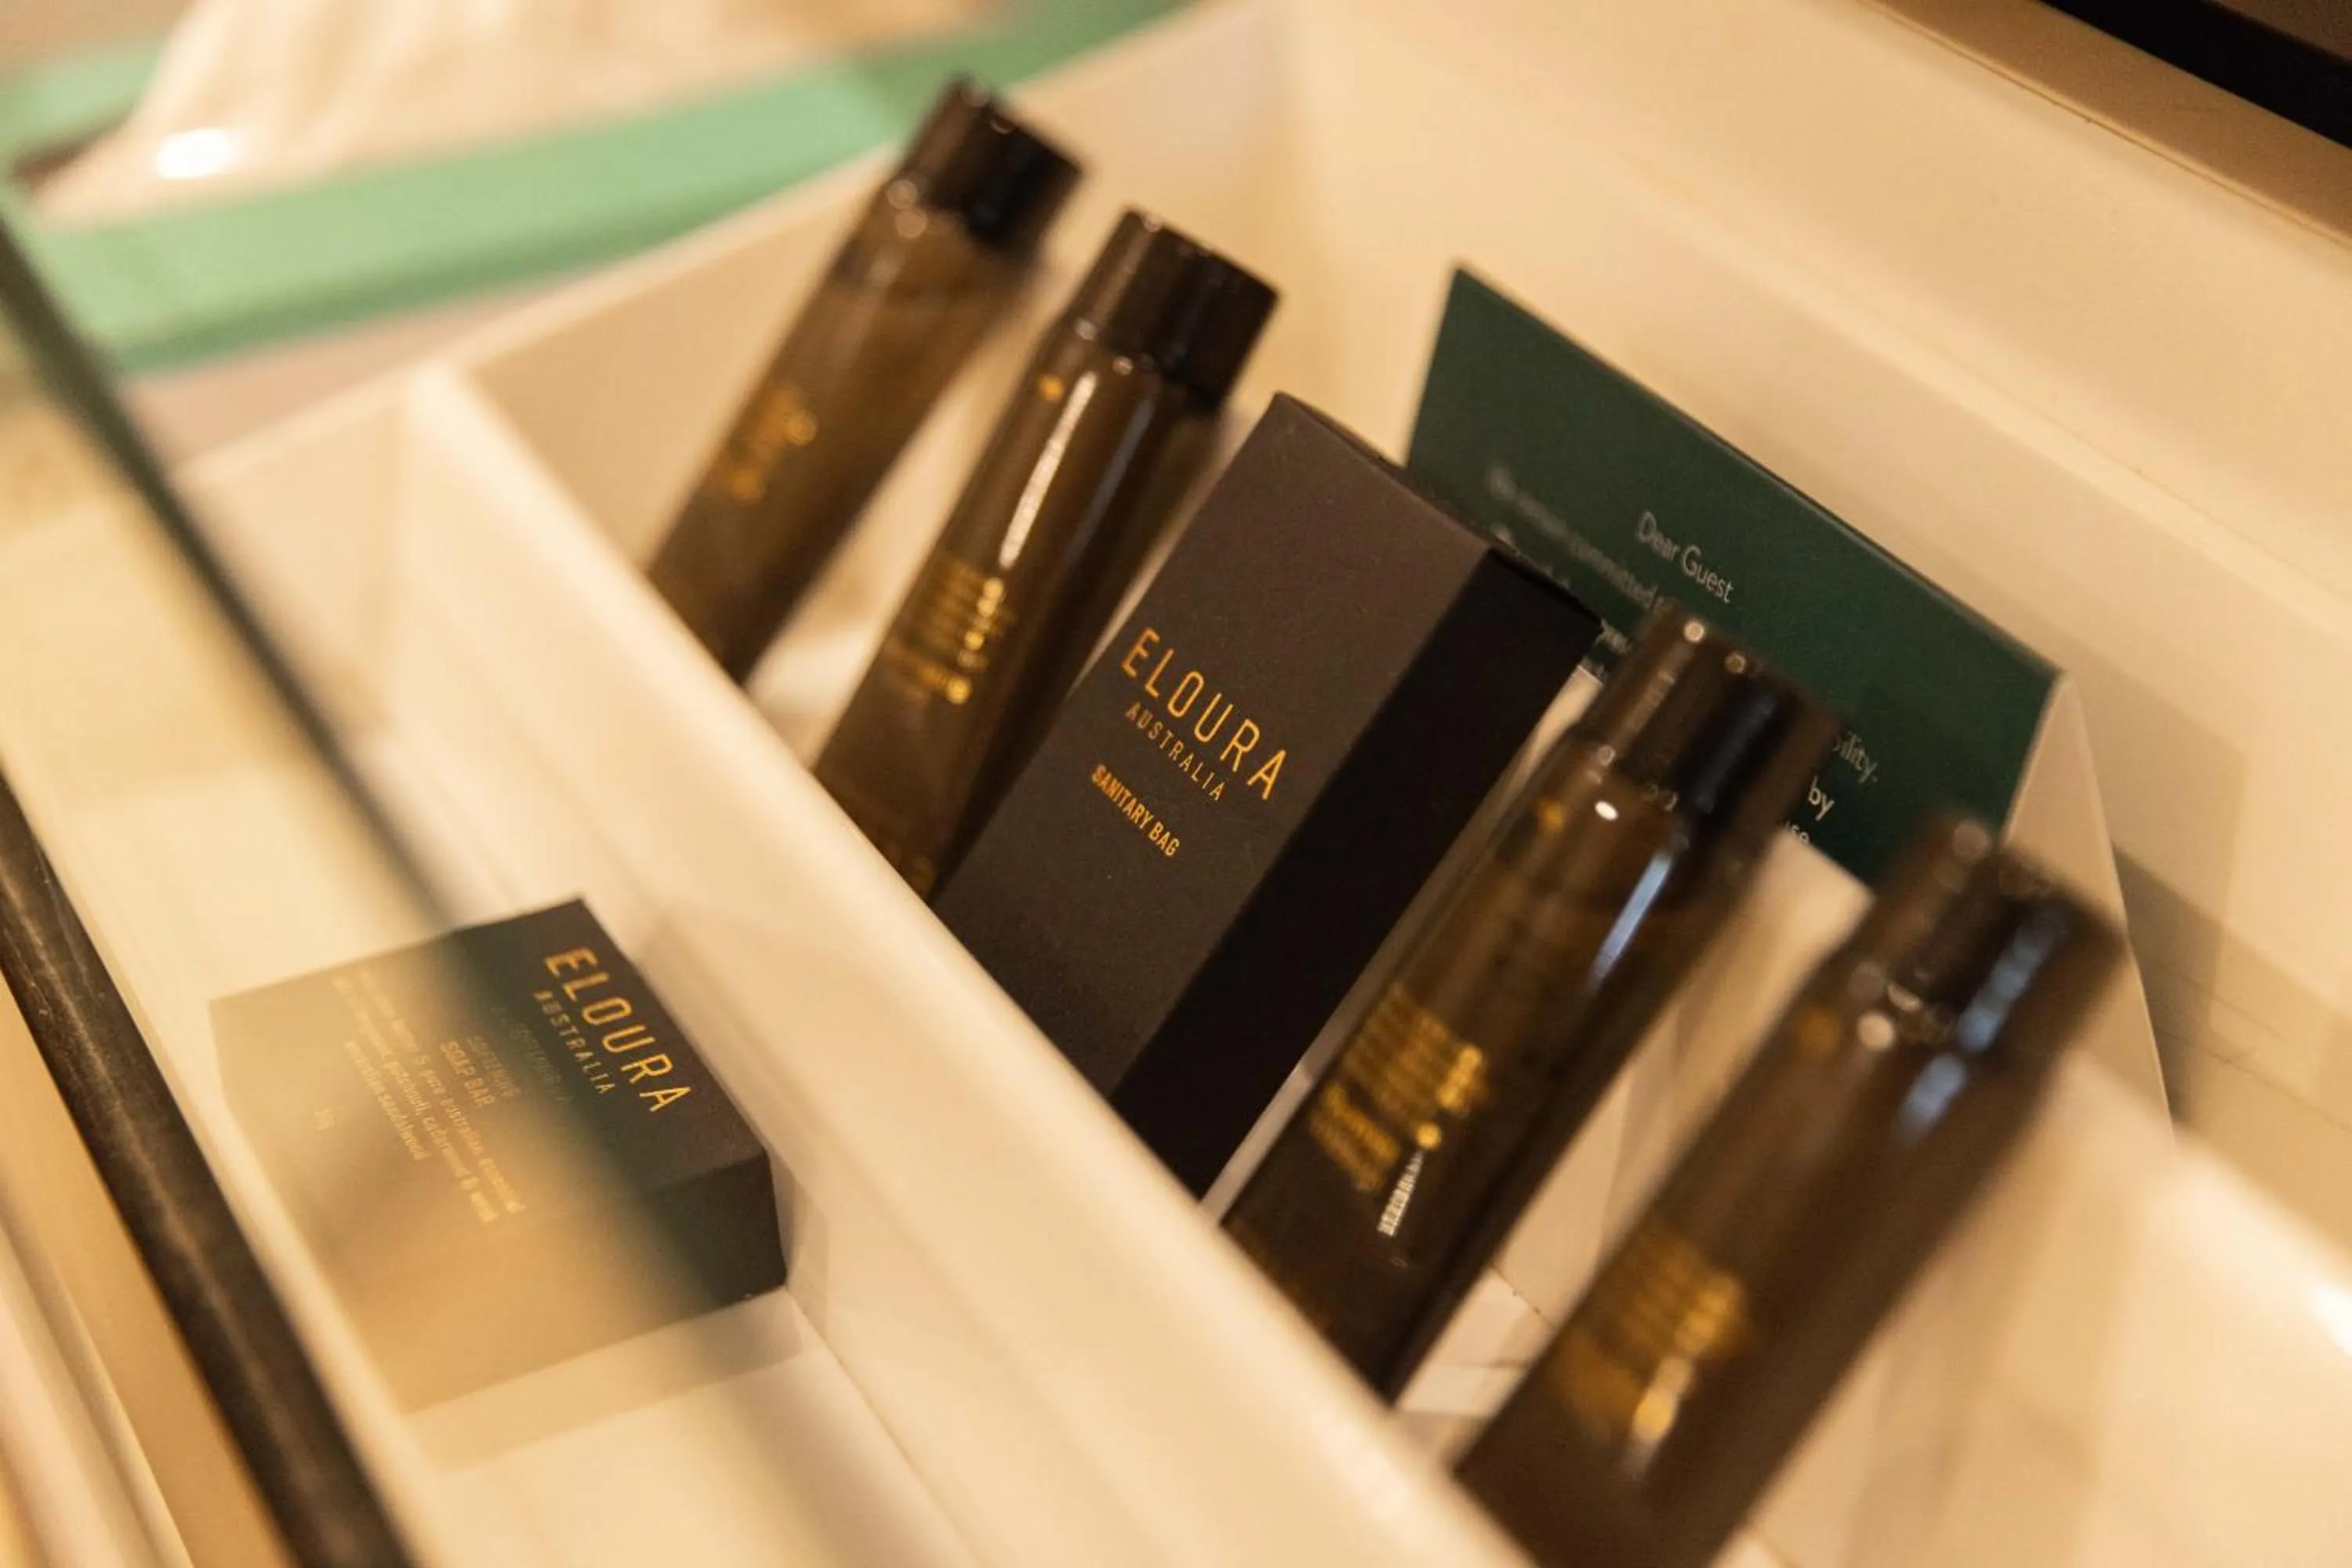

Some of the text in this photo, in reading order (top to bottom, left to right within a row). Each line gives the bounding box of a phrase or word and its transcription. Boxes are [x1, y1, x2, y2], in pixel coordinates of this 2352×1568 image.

[1637, 510, 1733, 603] Dear Guest
[1121, 626, 1287, 801] ELOURA
[1125, 702, 1225, 801] AUSTRALIA
[1091, 764, 1180, 857] SANITARY BAG
[1808, 775, 1835, 822] by
[440, 1040, 495, 1106] SOAP BAR
[532, 990, 615, 1094] AUSTRALIA
[545, 947, 691, 1112] ELOURA
